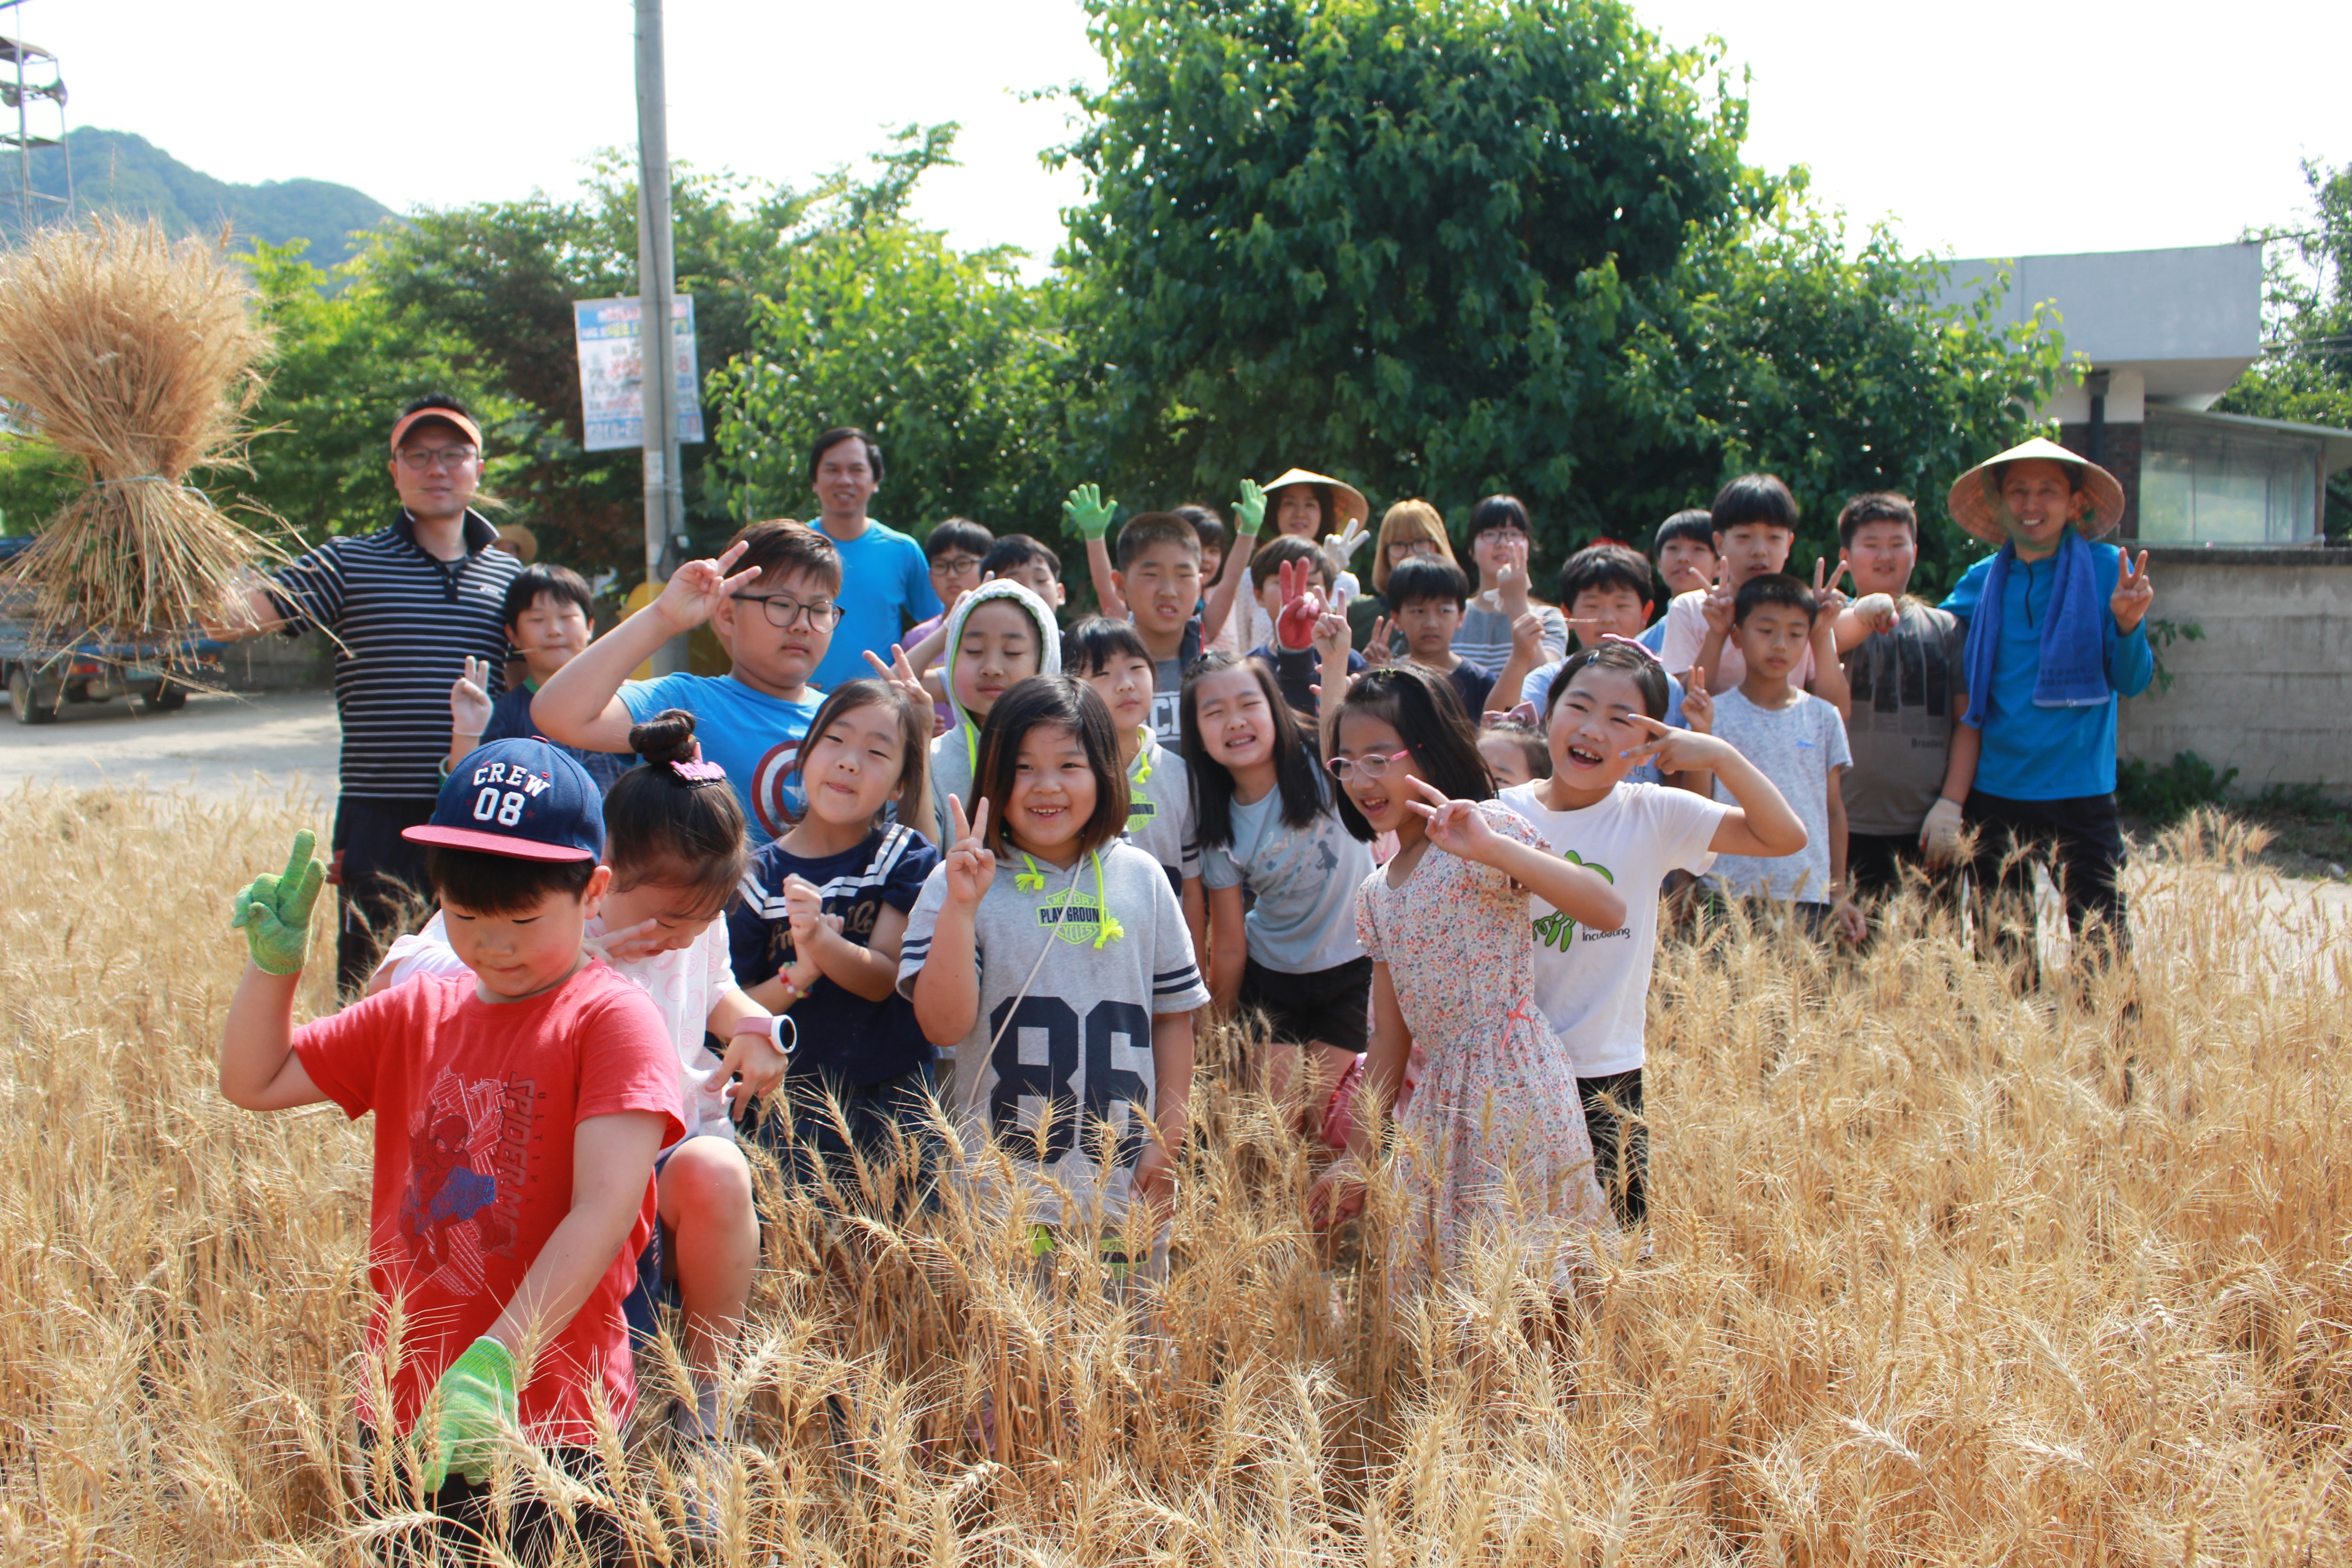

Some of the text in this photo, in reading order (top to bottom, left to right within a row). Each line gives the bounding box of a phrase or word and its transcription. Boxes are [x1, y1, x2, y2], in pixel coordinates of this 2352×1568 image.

[473, 763, 551, 797] CREW
[473, 787, 525, 826] 08
[1053, 892, 1090, 905] MOOR
[1067, 907, 1106, 923] GROUN
[990, 995, 1151, 1169] 86
